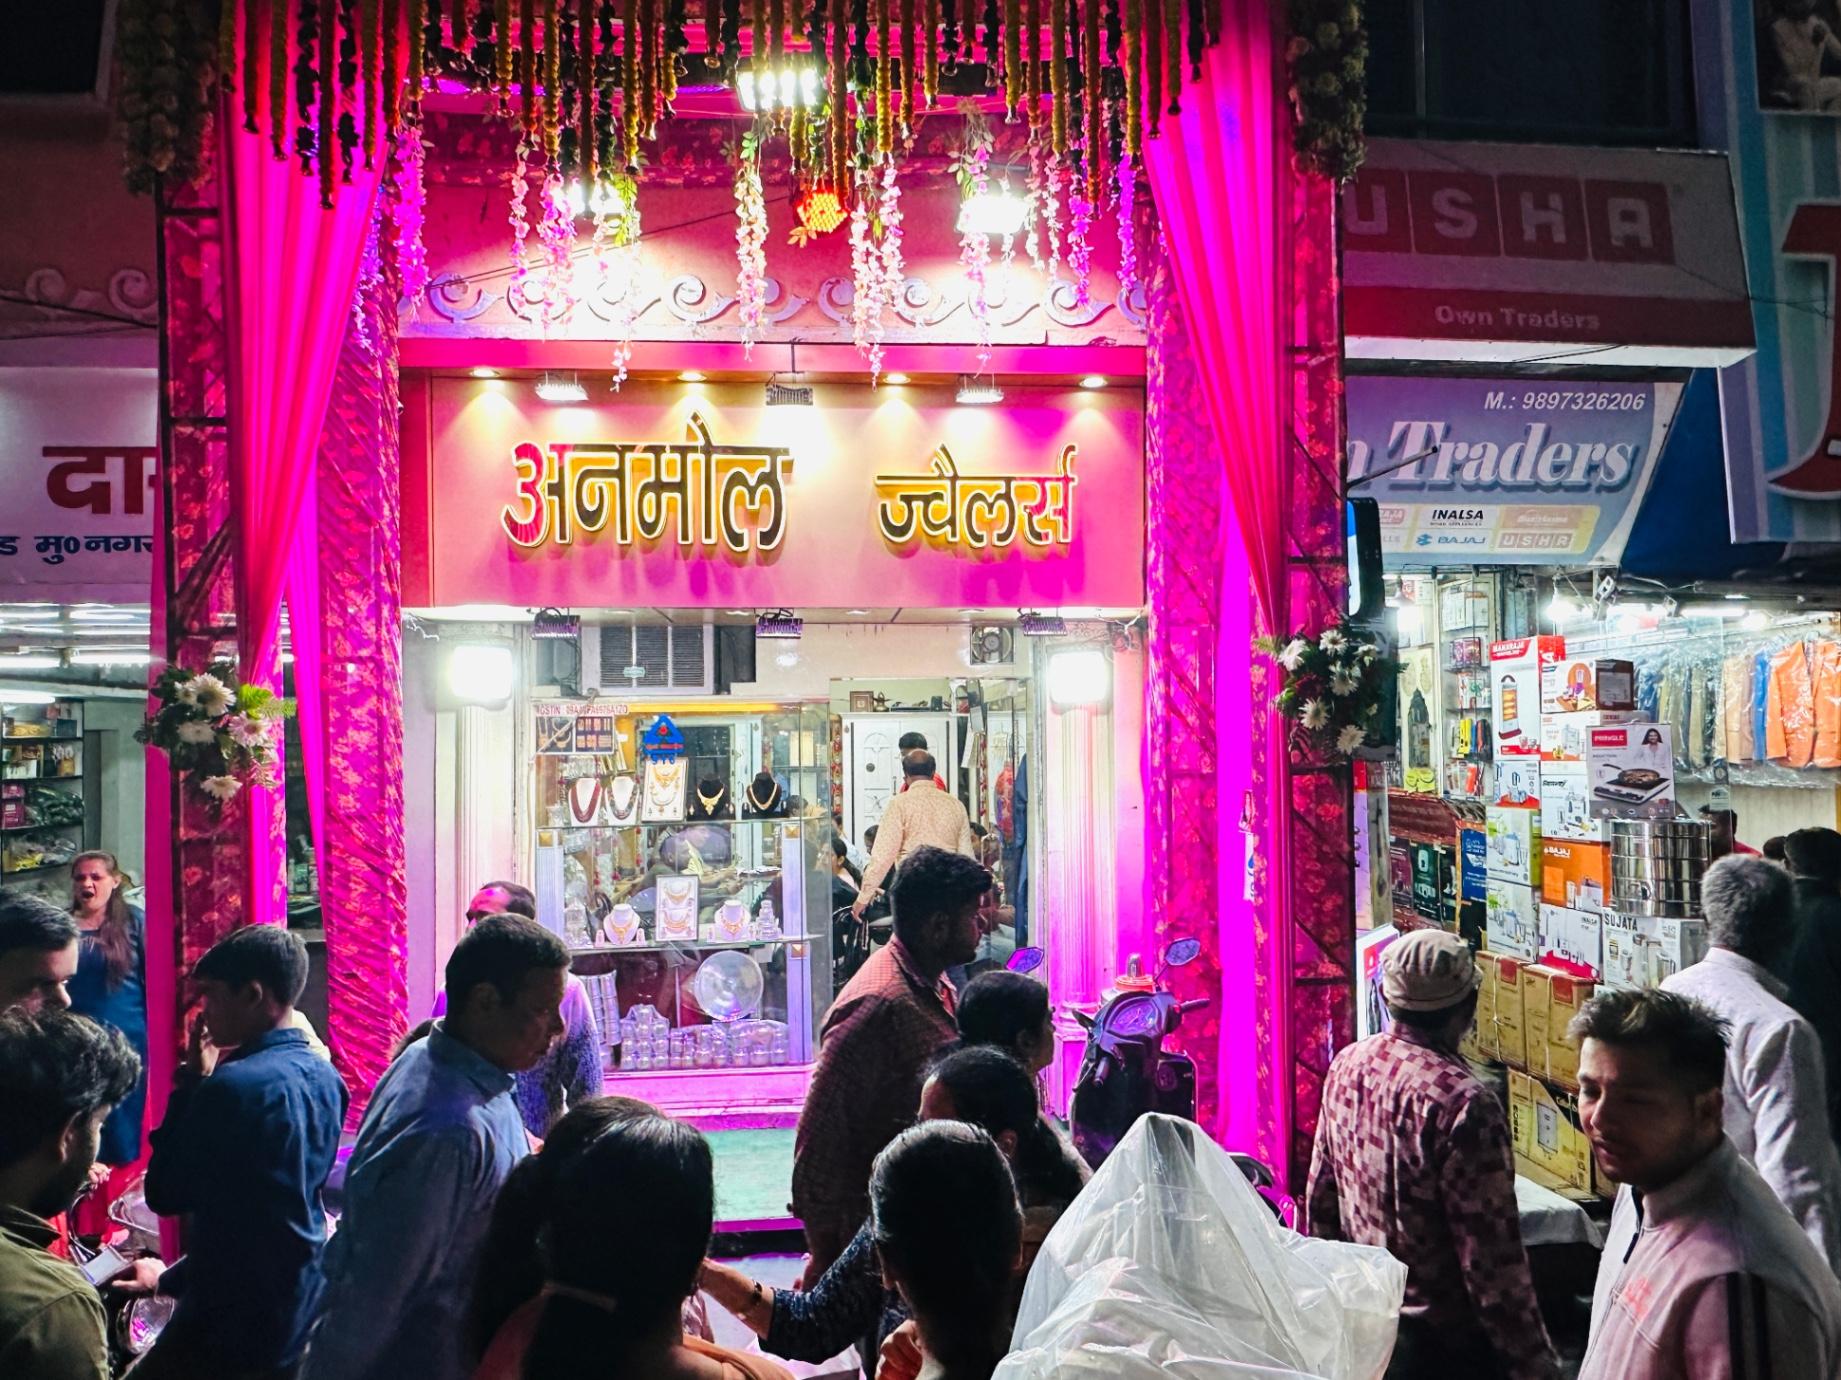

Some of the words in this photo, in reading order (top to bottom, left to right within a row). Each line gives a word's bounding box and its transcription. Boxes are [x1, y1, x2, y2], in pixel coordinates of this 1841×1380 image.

[1343, 184, 1654, 249] USHA
[1434, 305, 1494, 326] Own
[1499, 306, 1602, 331] Traders
[1521, 391, 1647, 411] 9897326206
[1388, 421, 1634, 487] Traders
[42, 446, 157, 514] दा
[501, 409, 795, 553] अनमोल
[1432, 509, 1484, 520] INALSA
[1437, 536, 1487, 544] BAJAJ
[1604, 913, 1638, 932] SUJATA
